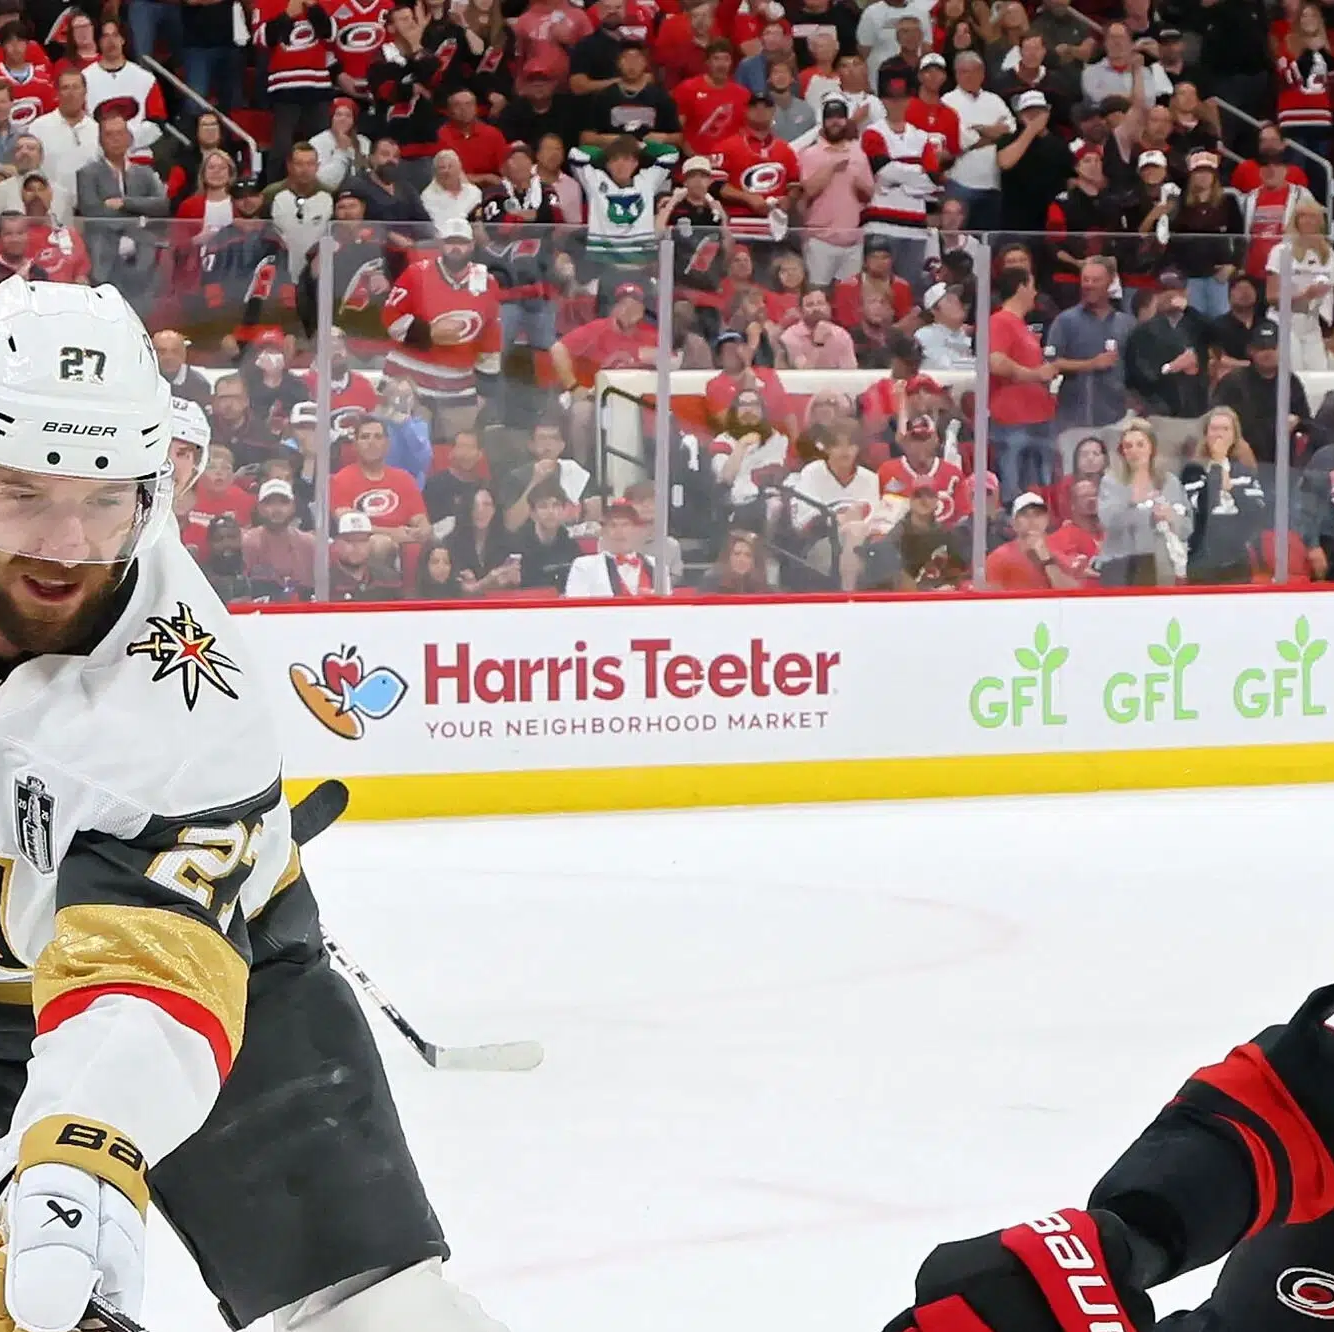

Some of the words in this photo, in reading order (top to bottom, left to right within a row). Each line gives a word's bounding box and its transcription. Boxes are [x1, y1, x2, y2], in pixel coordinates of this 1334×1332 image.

[58, 346, 107, 383] 27
[42, 421, 118, 438] BAUER
[424, 641, 623, 706] Harris
[630, 637, 841, 700] Teeter
[970, 648, 1068, 729] GFL
[1103, 643, 1200, 722] GFL
[1233, 638, 1328, 719] GFL
[425, 721, 493, 740] YOUR
[506, 714, 717, 738] NEIGHBORHOOD
[727, 711, 829, 732] MARKET
